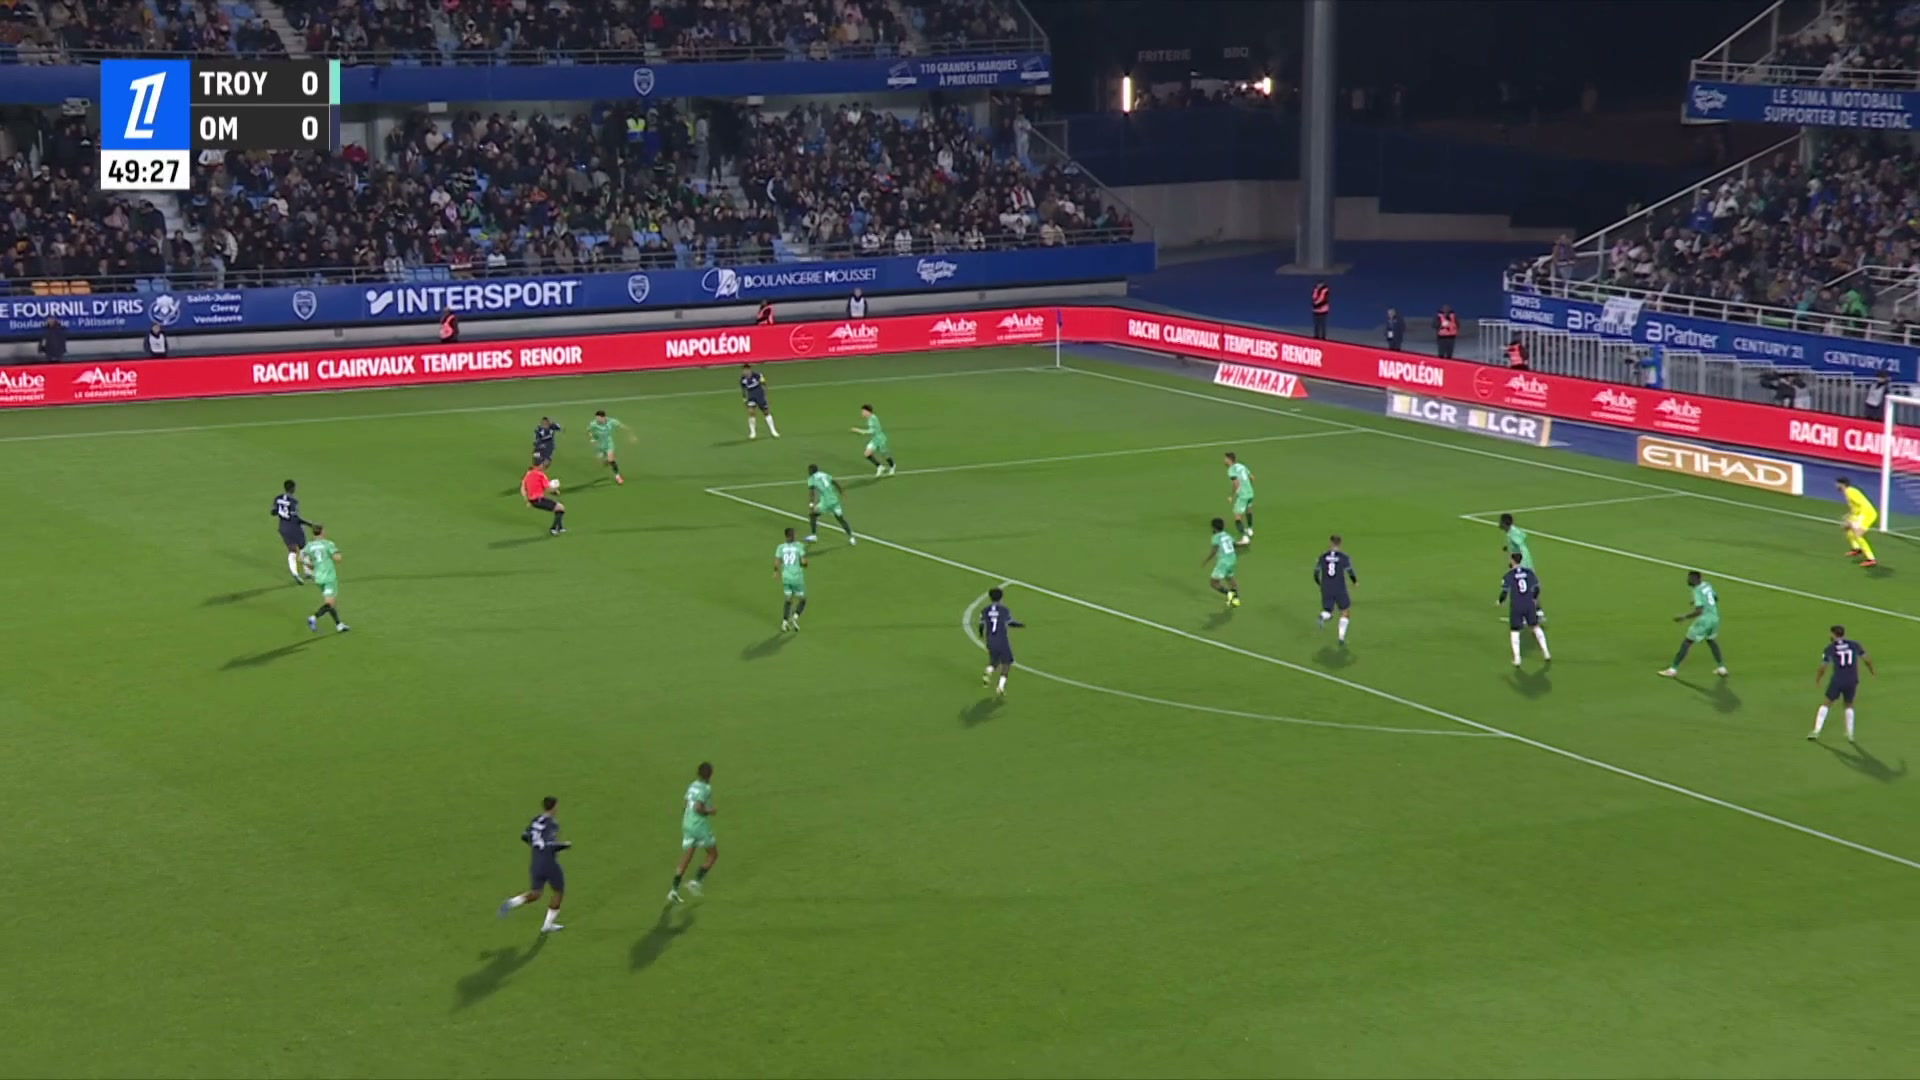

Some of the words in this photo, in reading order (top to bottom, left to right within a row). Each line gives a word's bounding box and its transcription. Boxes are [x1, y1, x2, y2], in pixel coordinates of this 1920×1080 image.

[937, 61, 976, 73] GRANDES
[977, 59, 1018, 71] MARQUES
[947, 74, 966, 86] PRIX
[967, 73, 998, 84] OUTLET
[1773, 88, 1787, 104] LE
[1791, 89, 1828, 107] SUMA
[1831, 91, 1904, 110] MOTOBALL
[1764, 106, 1836, 125] SUPPORTER
[1840, 110, 1858, 126] DE
[1861, 110, 1912, 129] L'ESTAC
[744, 271, 822, 288] BOULANGERIE
[825, 268, 877, 283] MOUSSET
[187, 293, 242, 303] Saint-Julien
[397, 280, 577, 313] INTERSPORT
[13, 301, 89, 318] FOURNIL
[113, 299, 143, 315] IRIS
[844, 323, 879, 337] Aube
[944, 317, 977, 332] Aube
[1011, 312, 1044, 328] Aube
[666, 333, 751, 358] NAPOLÉON
[1128, 319, 1160, 340] RACHI
[1163, 325, 1221, 350] CLAIRVAUX
[1224, 334, 1278, 360] TEMPLIERS
[1281, 343, 1323, 367] RENOIR
[1664, 323, 1719, 349] Partner
[1733, 337, 1790, 357] CENTURY
[1791, 346, 1804, 360] 21
[253, 362, 309, 383] RACHI
[316, 356, 415, 379] CLAIRVAUX
[421, 350, 513, 373] TEMPLIERS
[520, 346, 582, 368] RENOIR
[1378, 359, 1444, 387] NAPOLÉON
[1824, 351, 1886, 370] CENTURY
[1887, 357, 1900, 373] 21
[93, 366, 138, 385] Aube
[1219, 364, 1293, 396] WINAMAX
[1516, 373, 1548, 394] Aube
[1411, 396, 1458, 424] LCR
[1487, 410, 1537, 438] LCR
[1789, 420, 1839, 448] RACHI
[1643, 445, 1788, 486] ETIHAD
[1518, 579, 1527, 593] 9
[990, 617, 998, 633] 7
